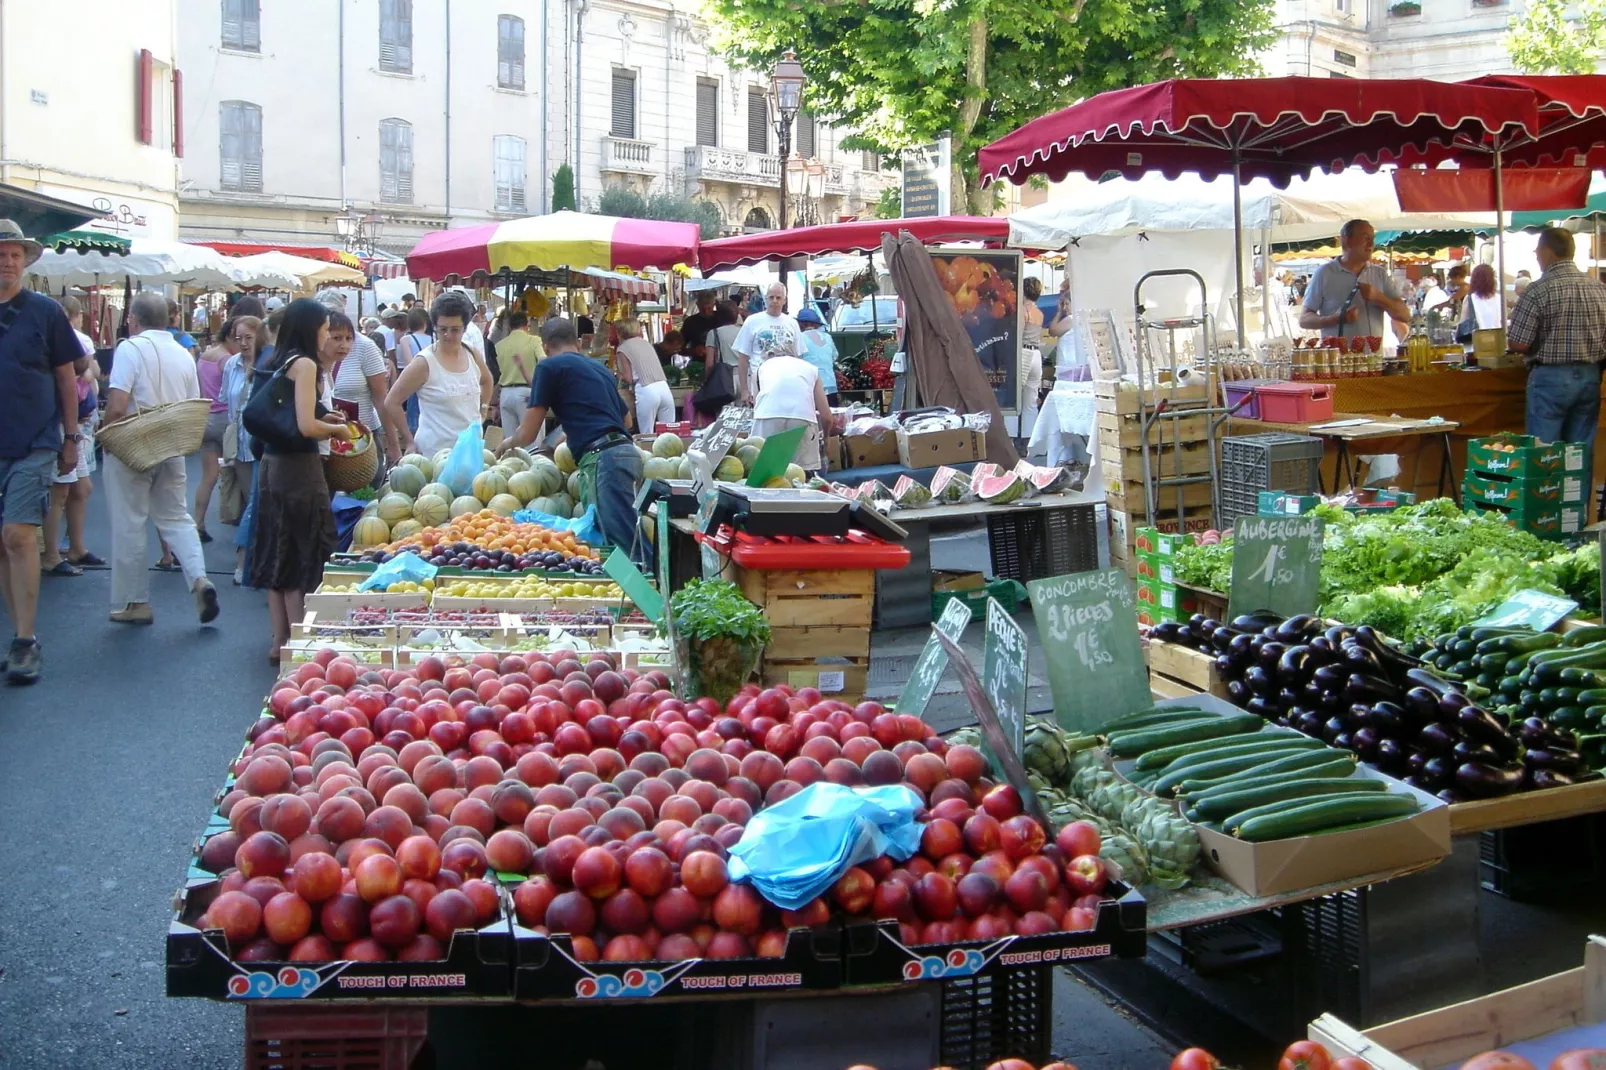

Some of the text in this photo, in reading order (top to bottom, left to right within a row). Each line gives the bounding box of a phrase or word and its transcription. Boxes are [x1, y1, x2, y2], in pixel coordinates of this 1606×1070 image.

[1157, 519, 1210, 534] ROVNCE
[1037, 571, 1118, 604] CONCOMBRE
[1000, 944, 1111, 965] TOUCH OF FRANCE
[338, 974, 466, 988] TOUCH OF FRANCE
[680, 973, 802, 988] TOUCH OF FRANCE
